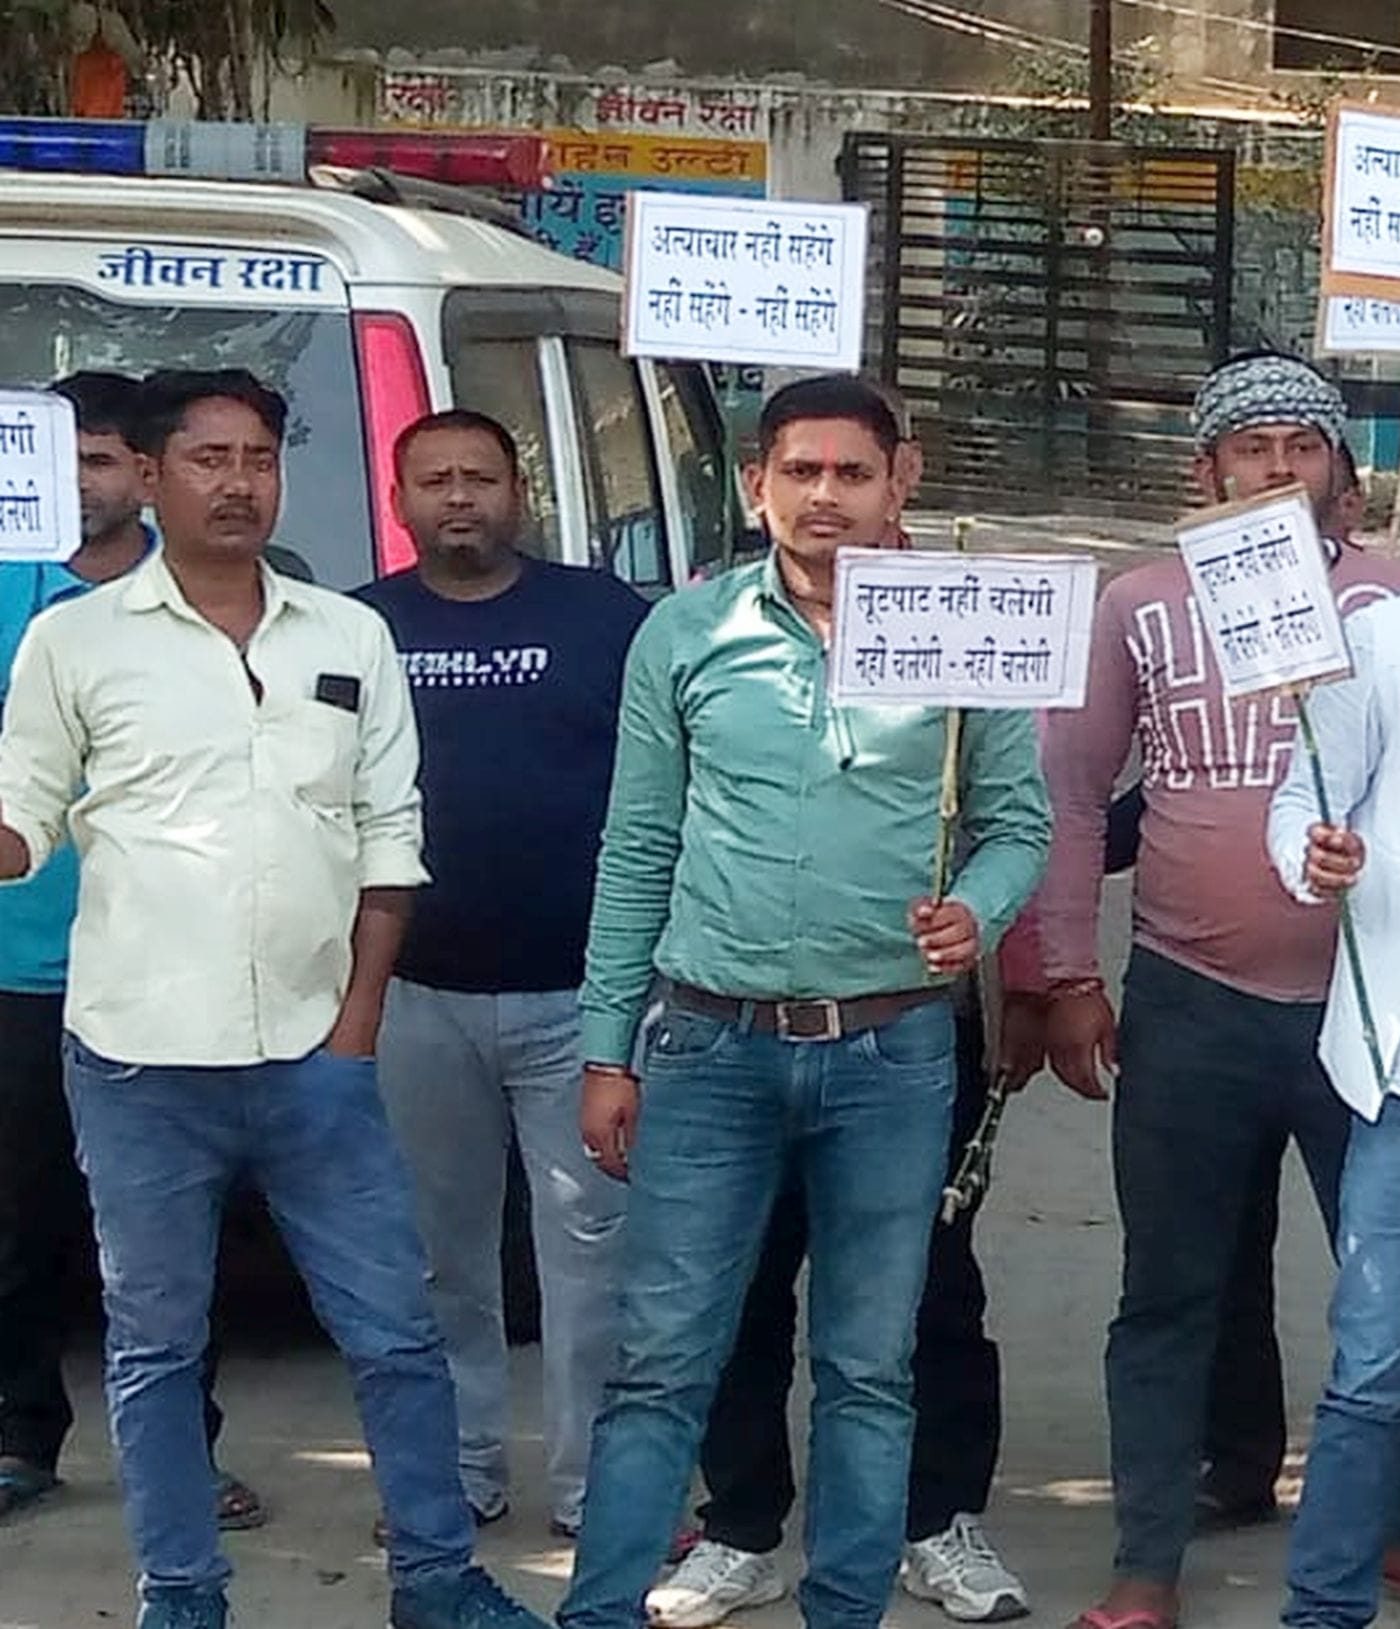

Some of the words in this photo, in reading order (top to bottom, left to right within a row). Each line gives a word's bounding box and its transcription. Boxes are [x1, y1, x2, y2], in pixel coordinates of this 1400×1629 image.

[1350, 196, 1381, 244] नहीं
[98, 246, 226, 288] जीवन
[237, 257, 326, 291] रक्षा
[651, 225, 737, 260] अत्याचार
[745, 221, 781, 268] नहीं
[788, 222, 834, 269] सहेंगे
[649, 277, 682, 327] नहीं
[689, 280, 732, 330] सहेंगे
[755, 285, 788, 336] नहीं
[795, 286, 837, 337] सहेंगे
[857, 584, 932, 624] लूटपाट
[939, 574, 982, 618] नहीं
[989, 577, 1054, 616] चलेगी
[856, 635, 888, 687] नहीं
[893, 635, 942, 680] चलेगी
[964, 636, 995, 688] नहीं
[1002, 638, 1051, 682] चलेगी
